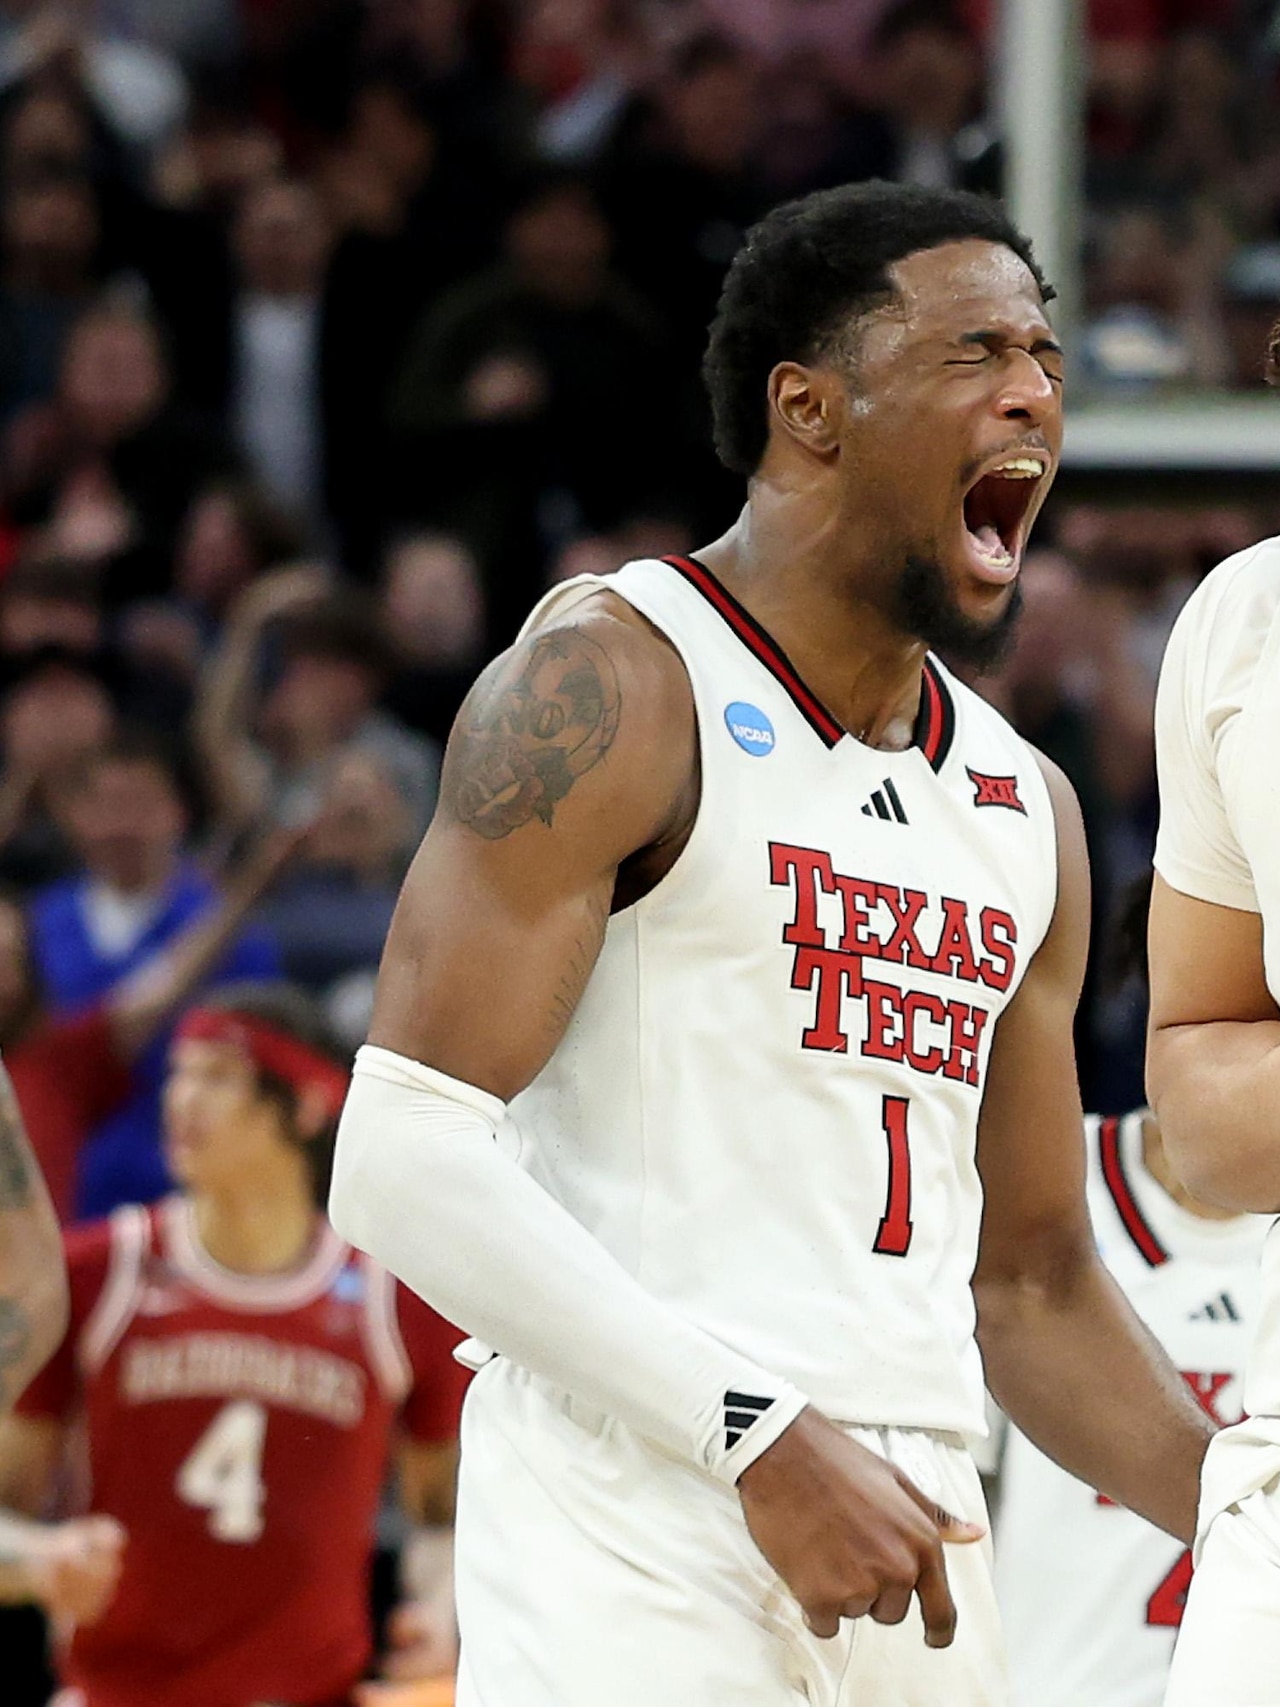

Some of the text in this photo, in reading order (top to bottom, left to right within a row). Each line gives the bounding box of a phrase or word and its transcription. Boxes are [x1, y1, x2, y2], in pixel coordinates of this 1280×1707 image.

[732, 723, 773, 746] NCAA
[768, 841, 1017, 993] TEXAS
[790, 946, 986, 1087] TECH
[872, 1094, 913, 1257] 1
[177, 1400, 267, 1544] 4
